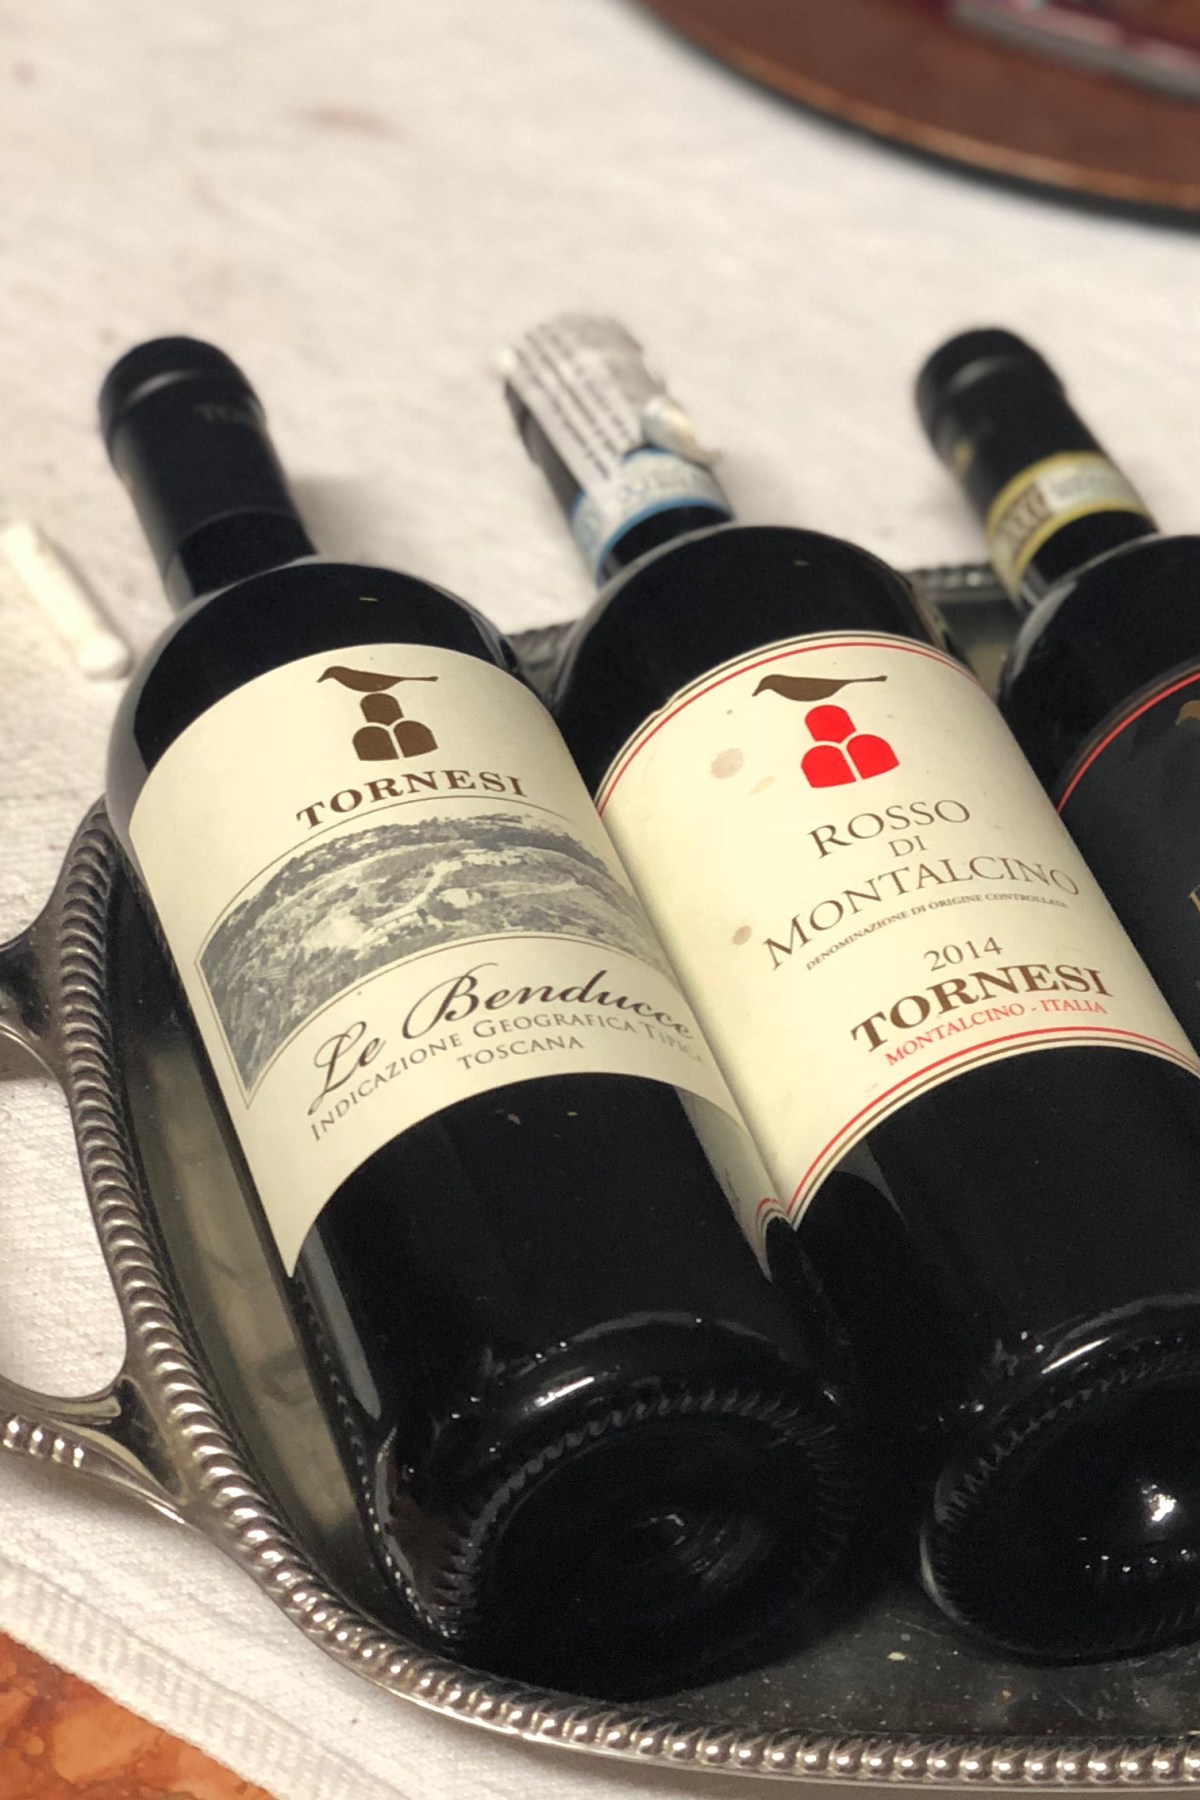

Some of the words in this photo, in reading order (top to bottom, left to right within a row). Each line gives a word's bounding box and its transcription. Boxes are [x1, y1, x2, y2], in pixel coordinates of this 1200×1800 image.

[296, 768, 528, 830] TORNESI
[807, 798, 971, 859] ROSSO
[888, 835, 928, 859] DI
[761, 856, 1081, 971] MONTALCINO
[806, 910, 910, 971] DENOMINAZIONE
[911, 904, 927, 916] DI
[928, 894, 983, 911] ORIGINE
[923, 936, 1003, 972] 2014
[307, 1020, 388, 1118] Le
[401, 962, 694, 1041] Benducce
[850, 961, 1114, 1053] TORNESI
[885, 1002, 1026, 1067] MONTALCINO
[1040, 997, 1108, 1018] ITALIA
[310, 1033, 463, 1141] INDICAZIONE
[472, 1013, 637, 1039] GEOGRAFICA
[638, 1021, 706, 1065] TIPIC
[457, 1035, 585, 1071] TOSCANA
